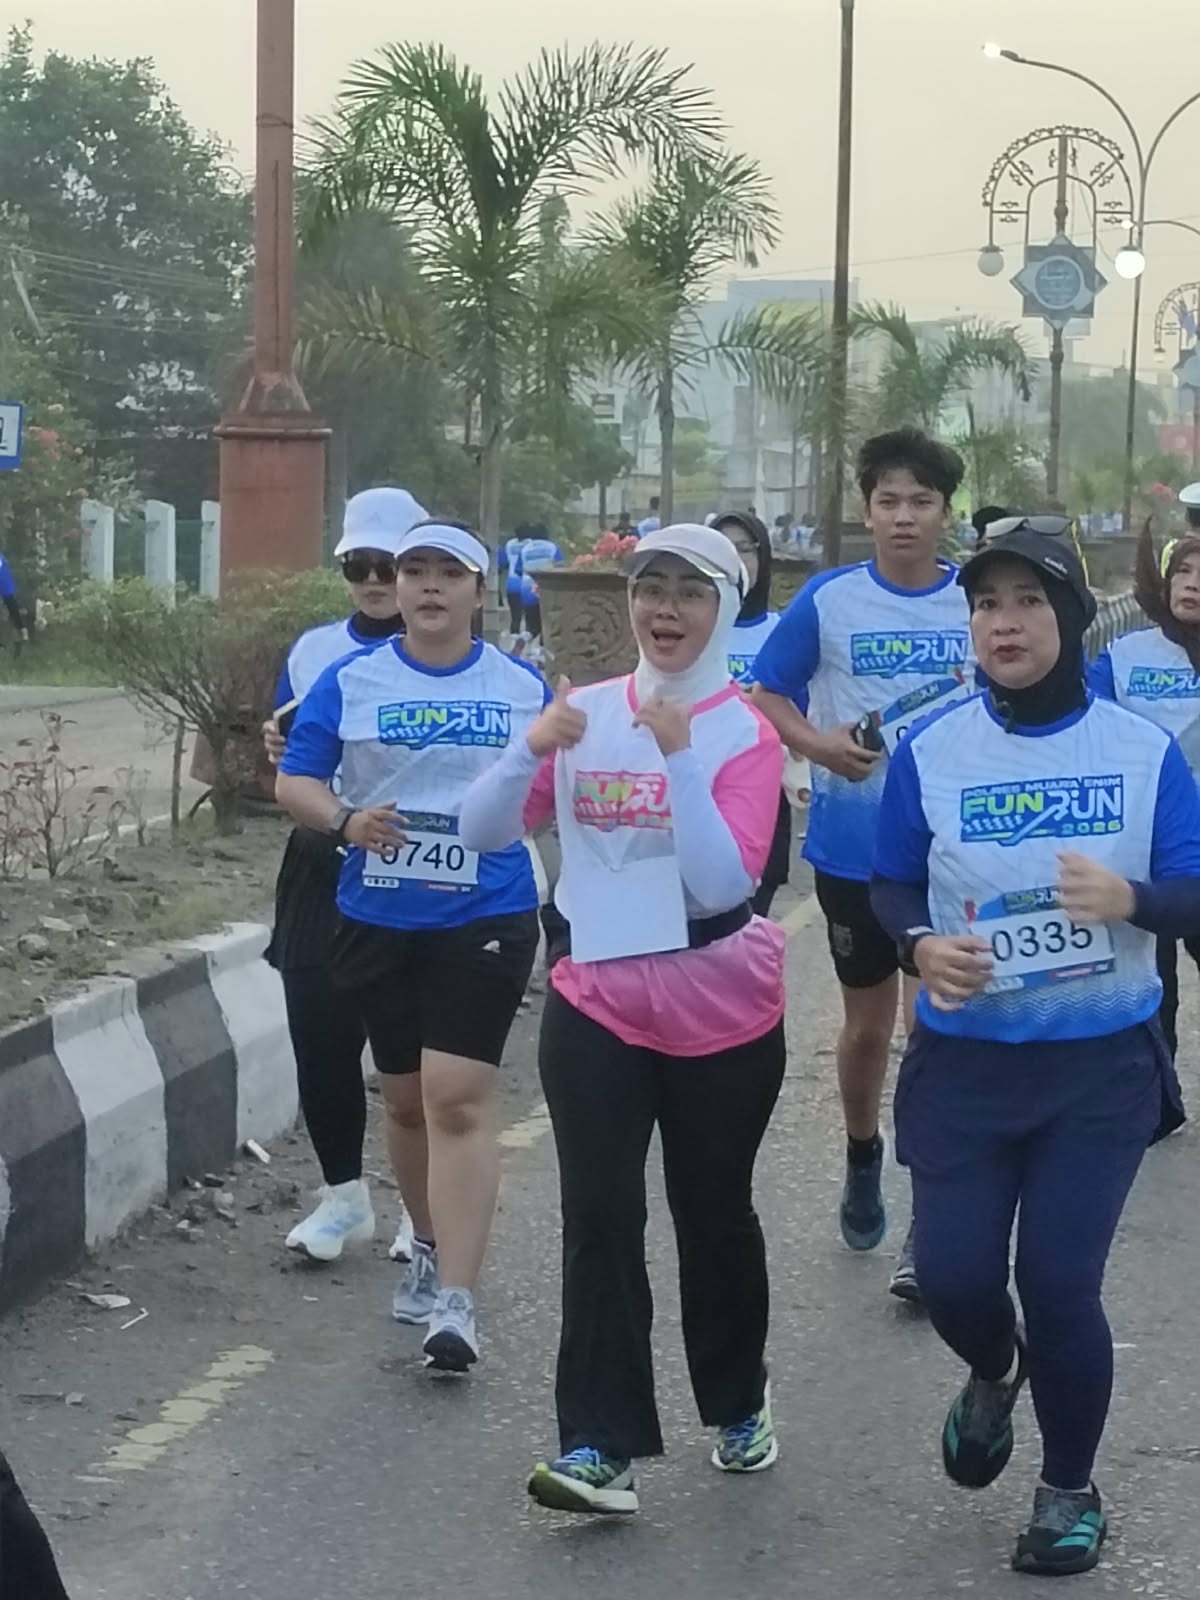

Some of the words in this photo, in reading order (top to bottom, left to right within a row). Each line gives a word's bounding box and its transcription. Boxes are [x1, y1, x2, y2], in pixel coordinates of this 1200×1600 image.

[854, 639, 912, 658] FUN
[914, 639, 966, 662] RUN
[1131, 672, 1176, 686] FUN
[380, 707, 448, 730] FUN
[450, 707, 509, 734] RUN
[962, 791, 1045, 821] FUN
[1047, 787, 1122, 822] RUN
[381, 840, 465, 871] 0740
[991, 921, 1093, 962] 0335
